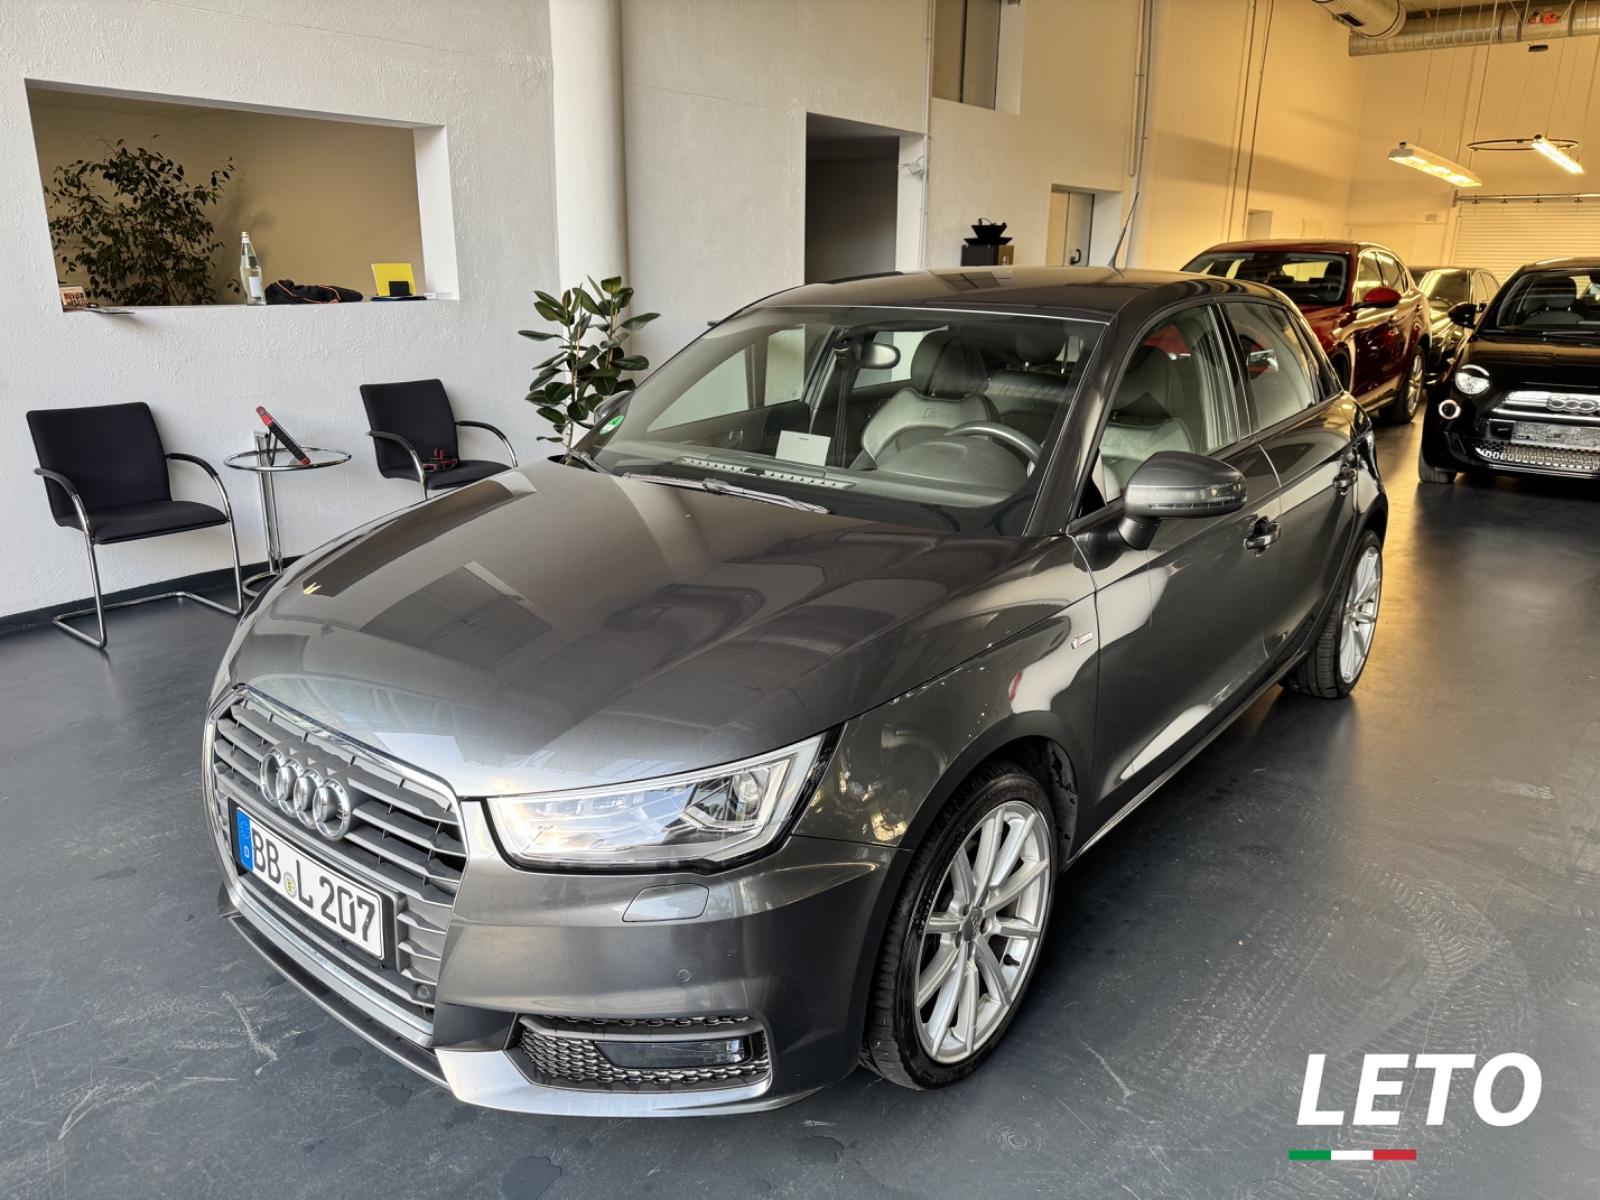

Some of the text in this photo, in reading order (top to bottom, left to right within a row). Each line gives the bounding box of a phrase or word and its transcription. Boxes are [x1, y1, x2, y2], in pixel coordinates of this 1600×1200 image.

[251, 827, 375, 943] BB L 207
